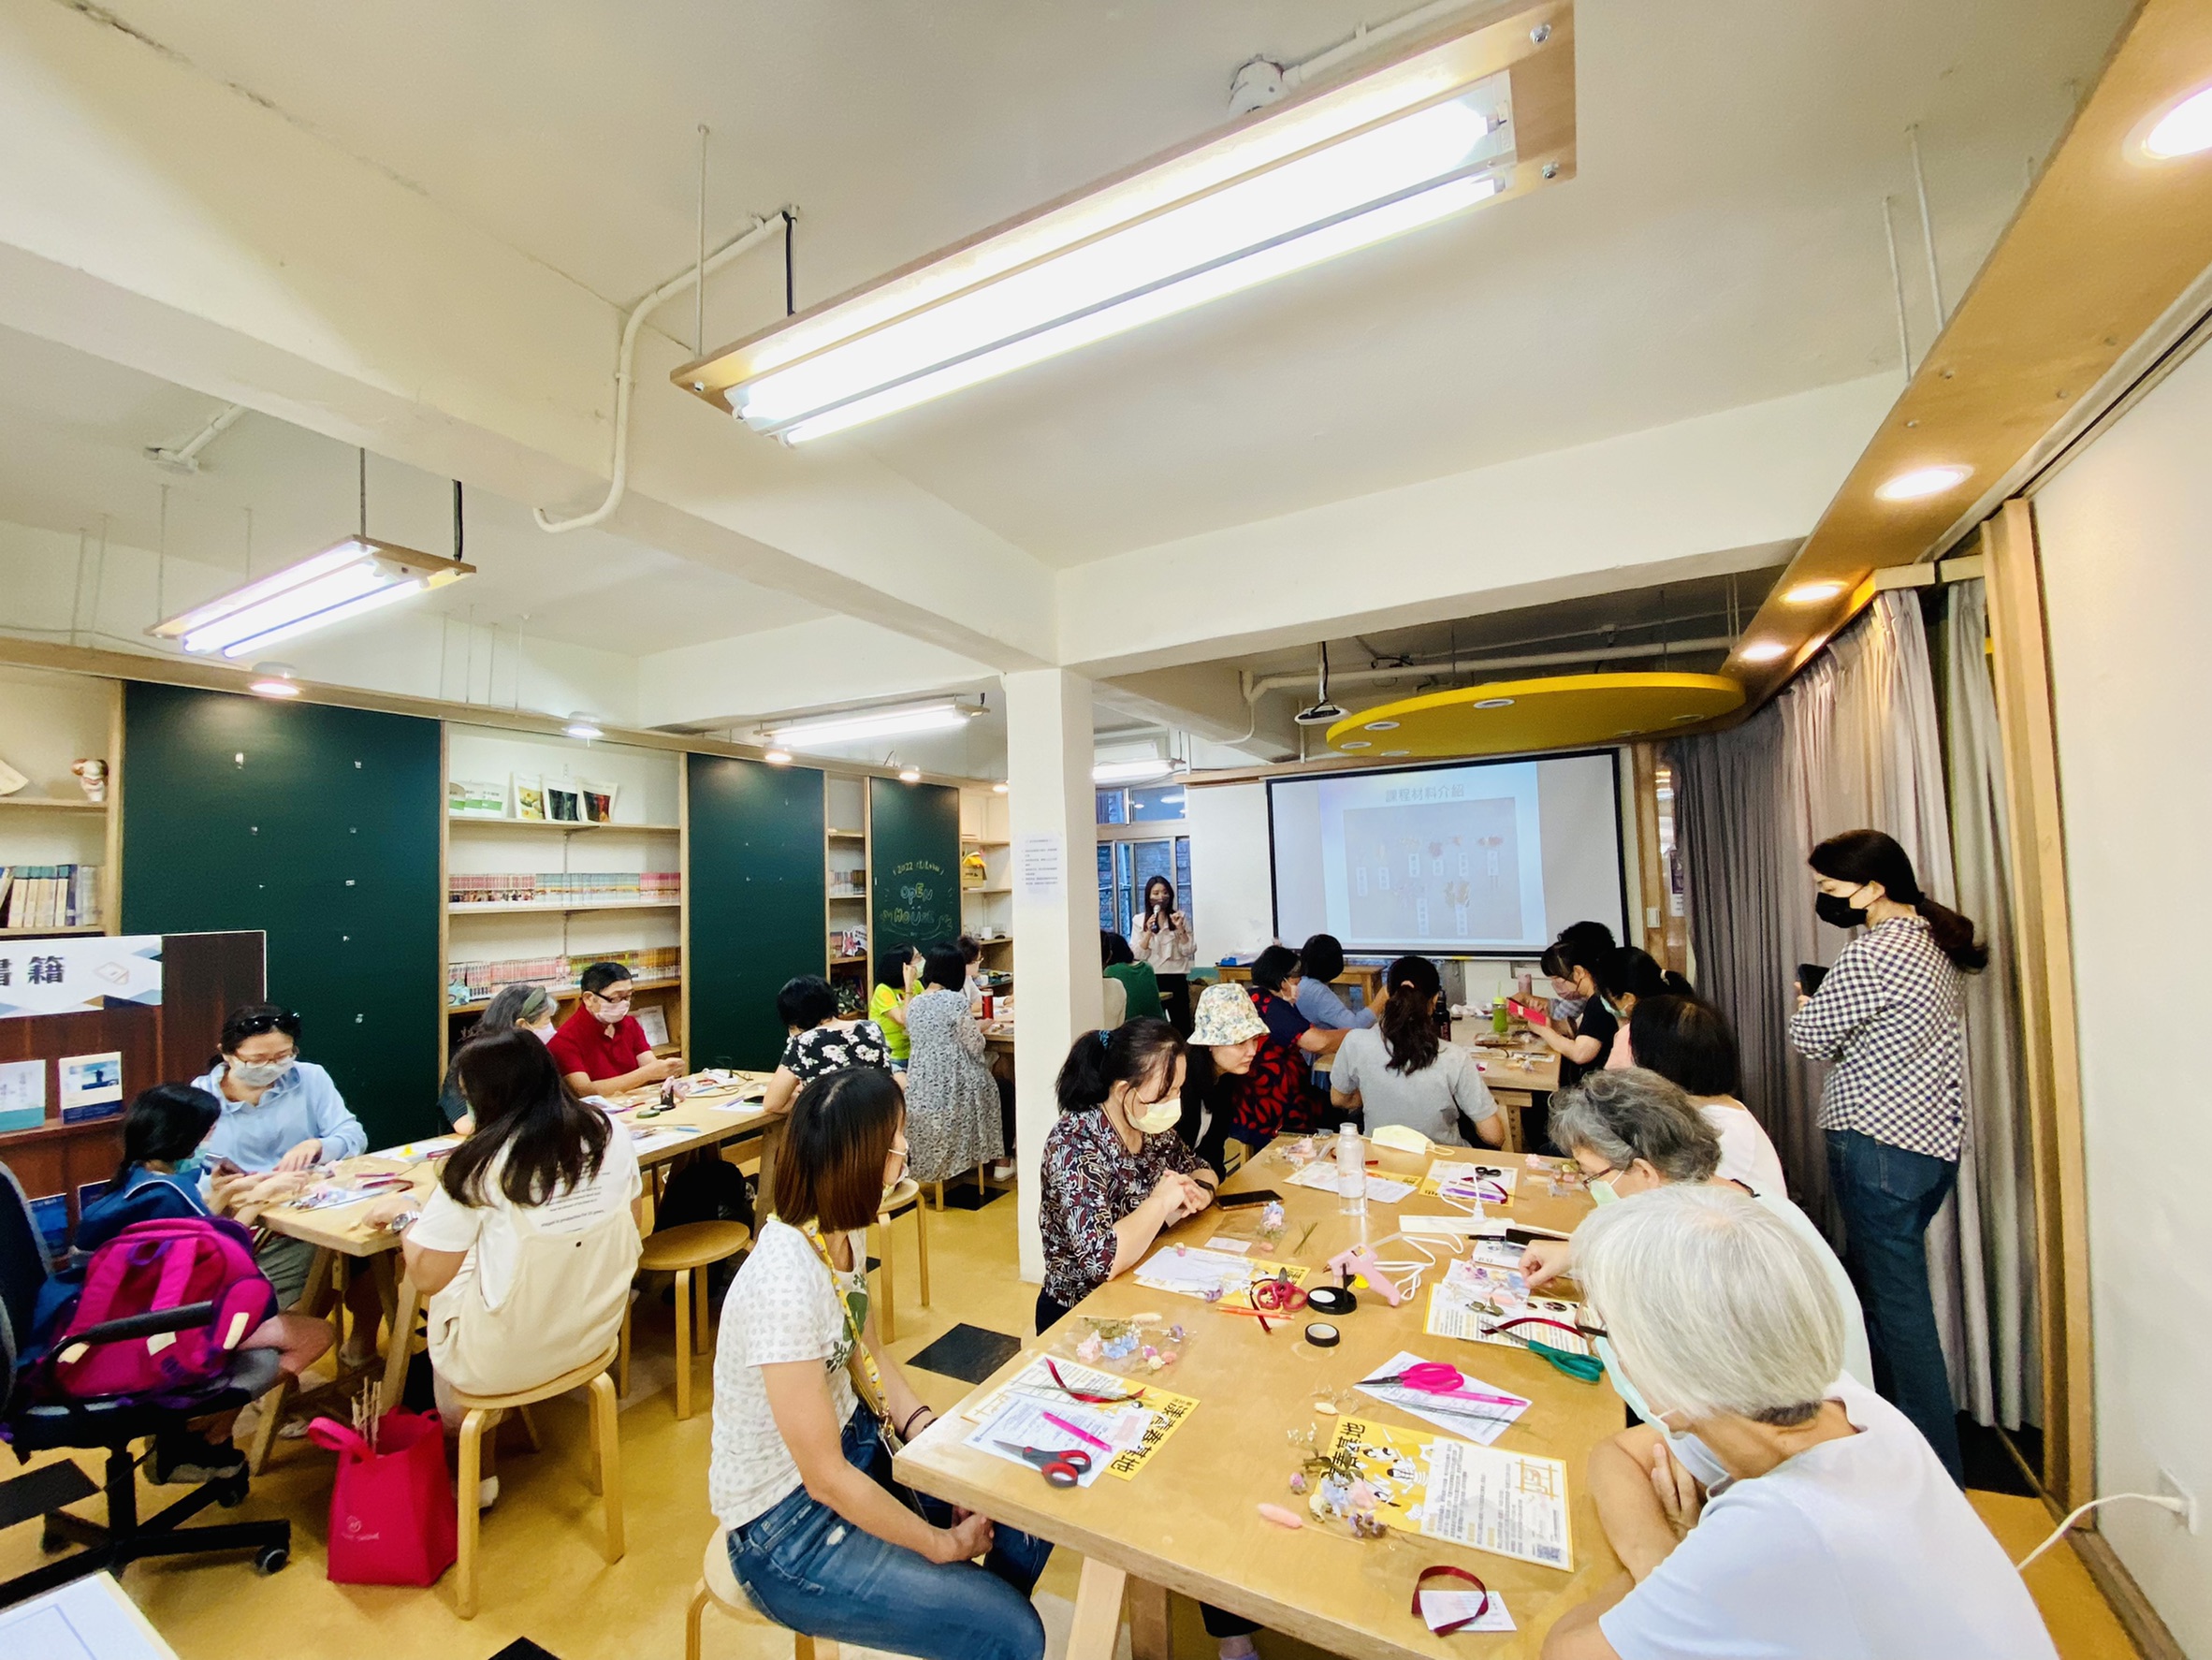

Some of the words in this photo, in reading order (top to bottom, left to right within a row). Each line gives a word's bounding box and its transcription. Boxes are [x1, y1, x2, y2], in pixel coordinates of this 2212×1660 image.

[1385, 783, 1464, 803] 課程材料介紹
